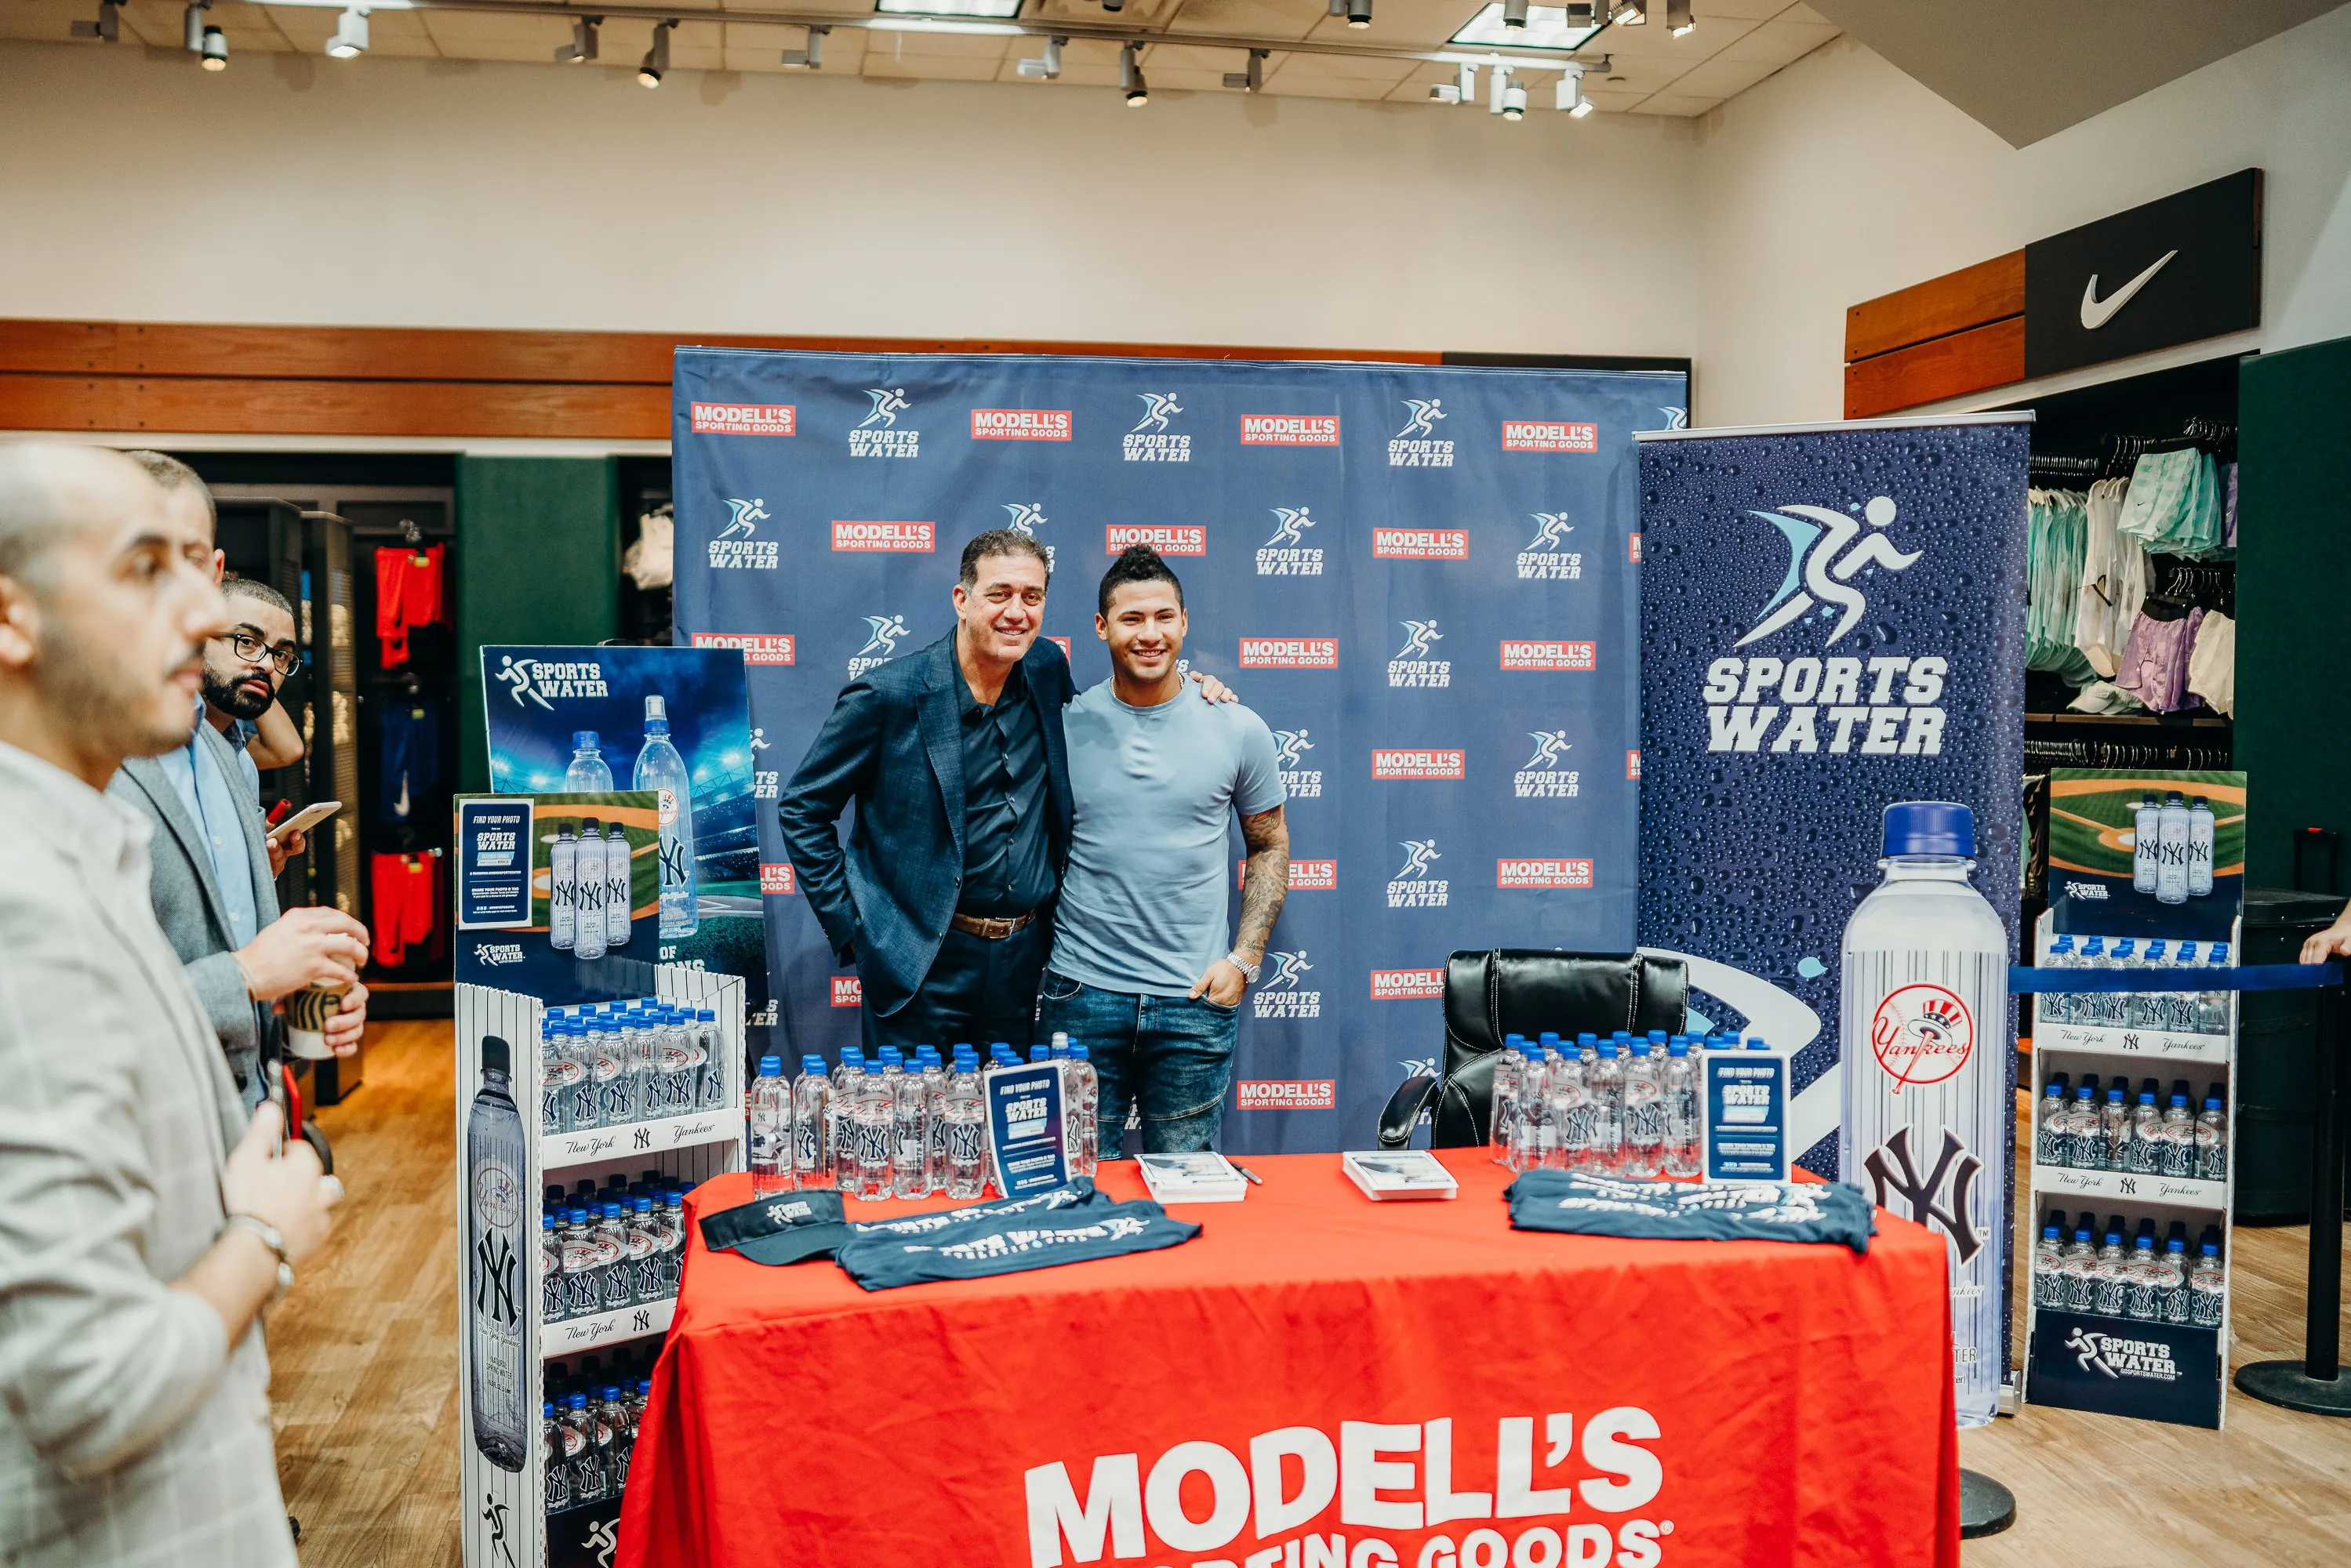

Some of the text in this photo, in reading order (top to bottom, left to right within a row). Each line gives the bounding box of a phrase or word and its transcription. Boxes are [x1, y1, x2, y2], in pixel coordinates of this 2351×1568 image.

[696, 406, 791, 425] MODELL'S
[976, 413, 1067, 429] MODELL'S
[753, 423, 791, 432] GOODS
[976, 426, 1067, 437] SPORTING GOODS
[1245, 419, 1335, 435] MODELL'S
[1506, 425, 1593, 441] MODELL'S
[848, 430, 919, 445] SPORTS
[1123, 434, 1190, 448] SPORTS
[1555, 440, 1593, 448] GOODS
[850, 443, 918, 457] WATER
[1388, 440, 1454, 454] SPORTS
[1124, 448, 1190, 461] WATER
[1390, 452, 1454, 466] WATER
[836, 524, 931, 539] MODELL'S
[1110, 528, 1201, 544] MODELL'S
[837, 539, 890, 547] SPORTING
[1377, 532, 1464, 548] MODELL'S
[709, 541, 778, 555] SPORTS
[1110, 543, 1162, 552] SPONG
[1378, 546, 1463, 555] SPORTING GOODS
[710, 554, 778, 568] WATER
[1256, 549, 1323, 563] SPORTS
[1517, 553, 1581, 567] SPORTS
[1257, 562, 1323, 575] WATER
[1518, 565, 1581, 579] WATER
[1244, 642, 1334, 658] MODELL'S
[1505, 644, 1591, 659] MODELL'S
[1388, 661, 1451, 675] SPORTS
[1557, 658, 1591, 666] GOODS
[532, 662, 601, 681] SPORTS
[1389, 673, 1450, 687] WATER
[1702, 656, 1948, 705] SPORTS
[538, 680, 609, 698] WATER
[1707, 706, 1946, 755] WATER
[1376, 753, 1460, 767] MODELL'S
[1280, 771, 1322, 783] ORTS
[1514, 771, 1579, 786] SPORTS
[1288, 784, 1322, 797] TER
[1516, 784, 1579, 797] WATER
[487, 815, 500, 824] YOUR
[477, 832, 516, 841] SPORTS
[478, 841, 515, 851] WATER
[1502, 862, 1589, 876] MODELL'S
[762, 883, 791, 891] OODS
[1387, 880, 1448, 895] SPORTS
[1388, 893, 1448, 907] WATER
[489, 945, 521, 953] SPORTS
[660, 946, 677, 960] OF
[492, 952, 523, 961] WATER
[1375, 972, 1442, 988] MODELL
[1253, 992, 1321, 1006] SPORTS
[1375, 988, 1423, 996] SPORTING
[1255, 1005, 1320, 1017] WATER
[1873, 1016, 1969, 1056] Yankees
[2061, 1029, 2082, 1040] New
[2083, 1032, 2106, 1046] York
[2163, 1037, 2206, 1051] Yankees
[1000, 1079, 1050, 1095] FIND YOUR PHOTO
[1241, 1083, 1331, 1098] MODELL'S
[1241, 1097, 1296, 1105] SPORTING
[1007, 1106, 1048, 1123] WATER
[565, 1122, 715, 1157] New York NY Yankees
[2058, 1172, 2203, 1197] New York NY Yankees
[476, 1226, 518, 1329] NY
[1951, 1280, 1982, 1295] nkees
[565, 1309, 650, 1342] New York NY
[2101, 1337, 2171, 1359] SPORTS
[1954, 1348, 1977, 1363] TER
[2105, 1352, 2176, 1374] WATER
[2120, 1368, 2175, 1381] GOSPORTSWATER.COM
[1025, 1406, 1663, 1568] MODELL'S
[1417, 1519, 1662, 1568] GOODS
